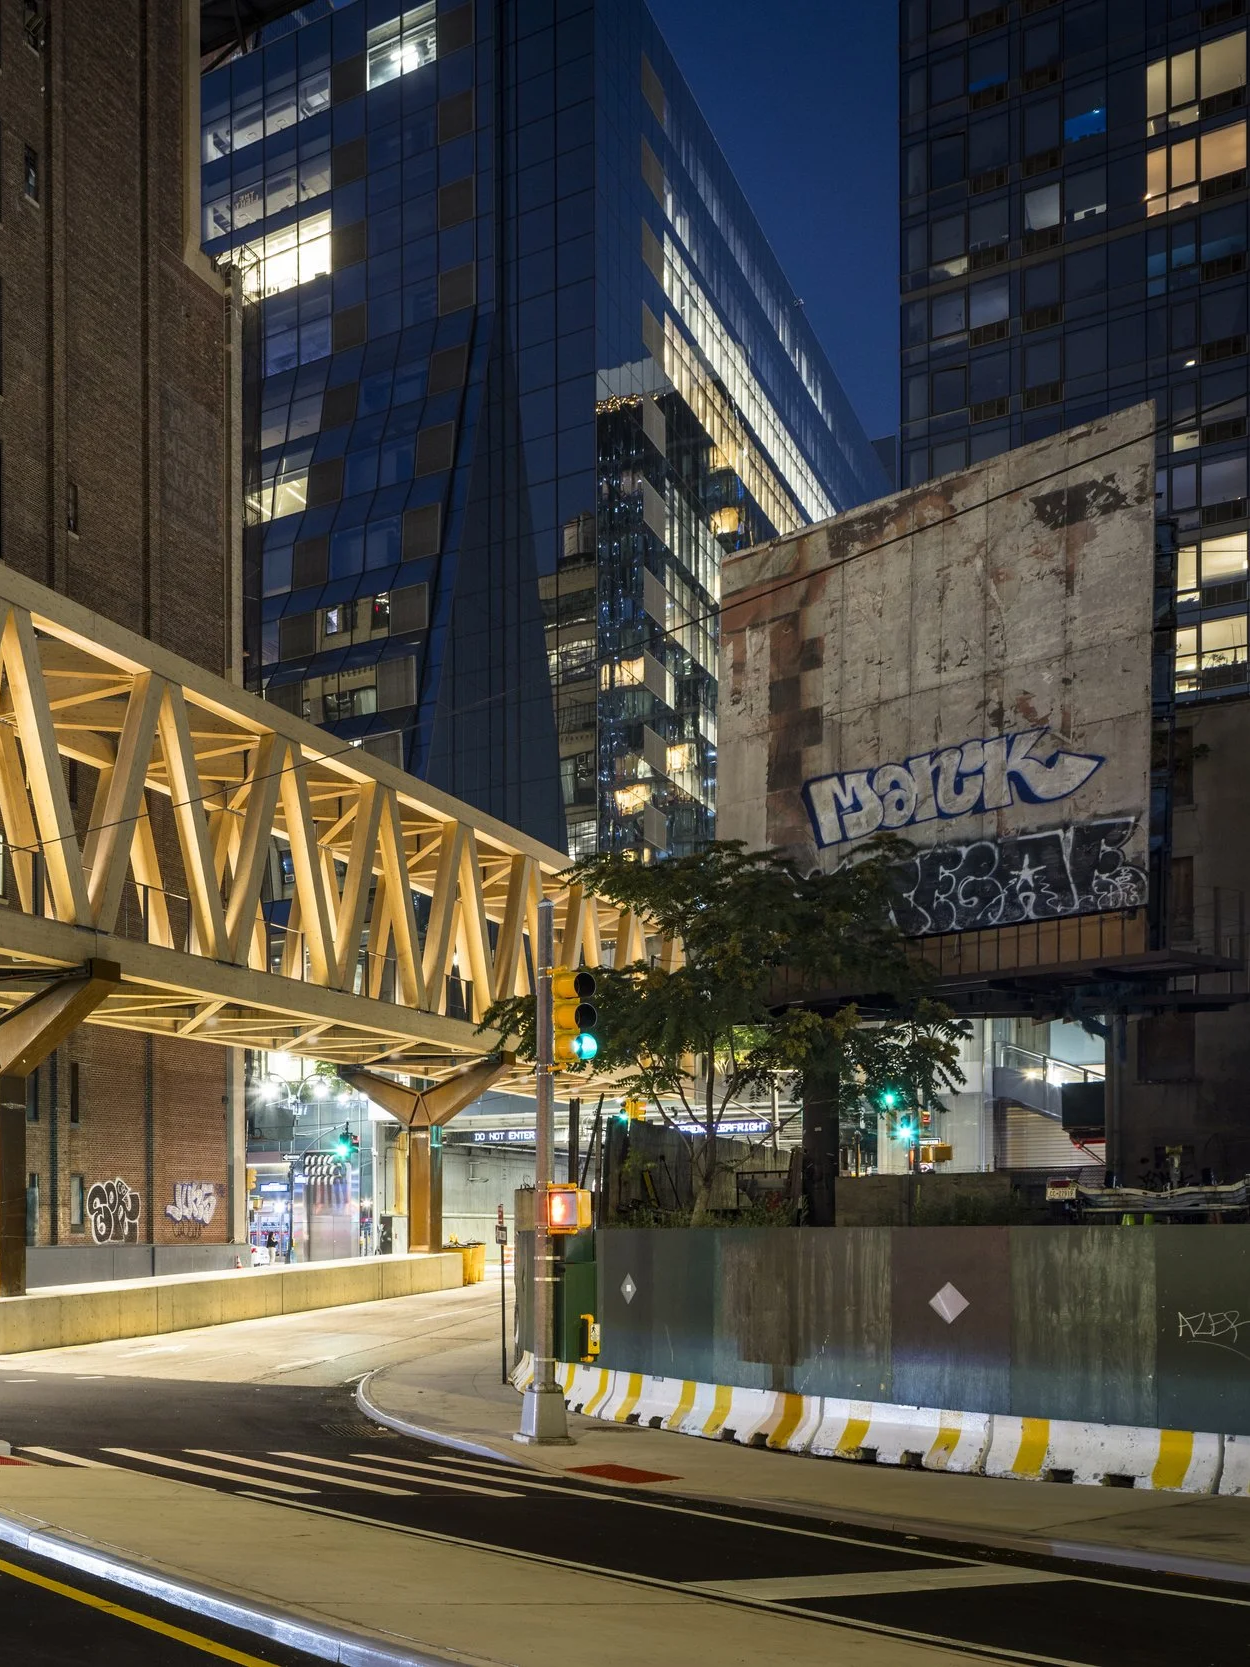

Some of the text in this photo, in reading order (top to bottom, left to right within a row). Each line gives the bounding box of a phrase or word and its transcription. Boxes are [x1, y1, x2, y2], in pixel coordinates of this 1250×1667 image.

[474, 1130, 535, 1141] DO NOT ENTER
